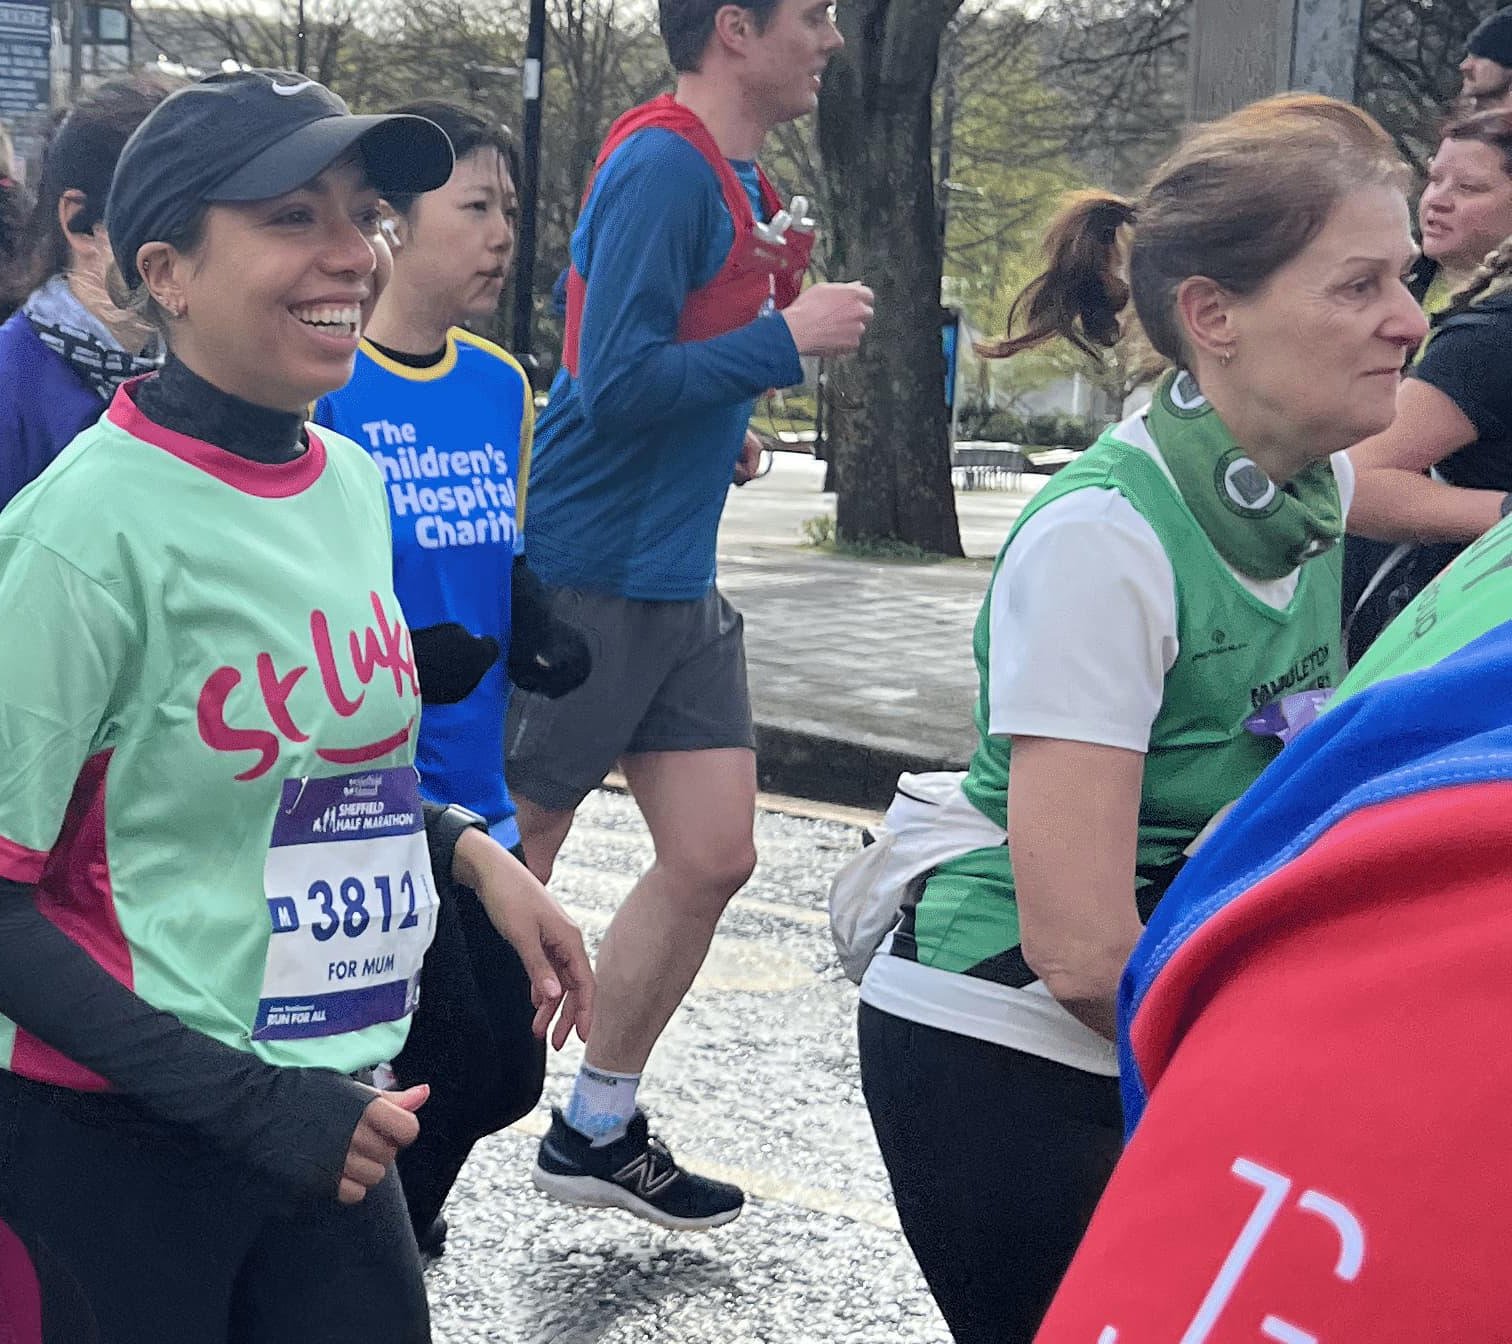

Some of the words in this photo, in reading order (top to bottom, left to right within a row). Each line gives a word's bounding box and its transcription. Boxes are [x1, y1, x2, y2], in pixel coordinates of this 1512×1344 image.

[361, 419, 417, 448] The
[372, 442, 509, 482] hildren's
[390, 476, 517, 517] Hospital
[197, 652, 310, 782] St
[336, 817, 362, 832] HALF
[362, 813, 415, 830] MARATHON
[338, 801, 385, 817] SHEFFIELD
[277, 906, 293, 928] M
[307, 870, 419, 942] 3812
[328, 959, 357, 981] FOR
[361, 954, 395, 977] MUM
[267, 1013, 290, 1026] RUN
[290, 1011, 310, 1025] FOR
[310, 1009, 327, 1023] ALL
